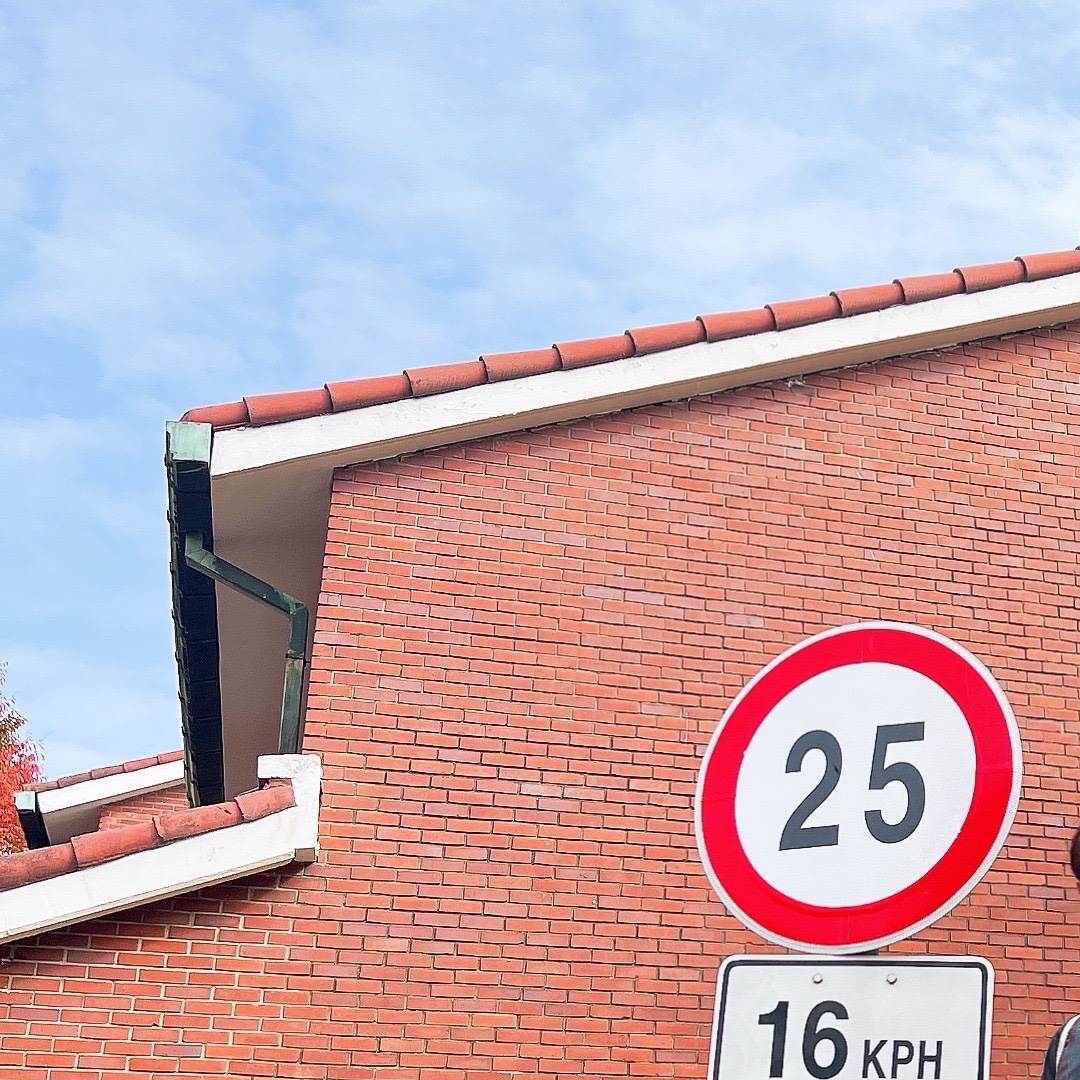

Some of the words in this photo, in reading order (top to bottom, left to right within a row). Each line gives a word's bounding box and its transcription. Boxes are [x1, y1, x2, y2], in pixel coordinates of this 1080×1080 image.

[779, 721, 926, 851] 25
[757, 999, 849, 1080] 16
[861, 1039, 943, 1080] KPH
